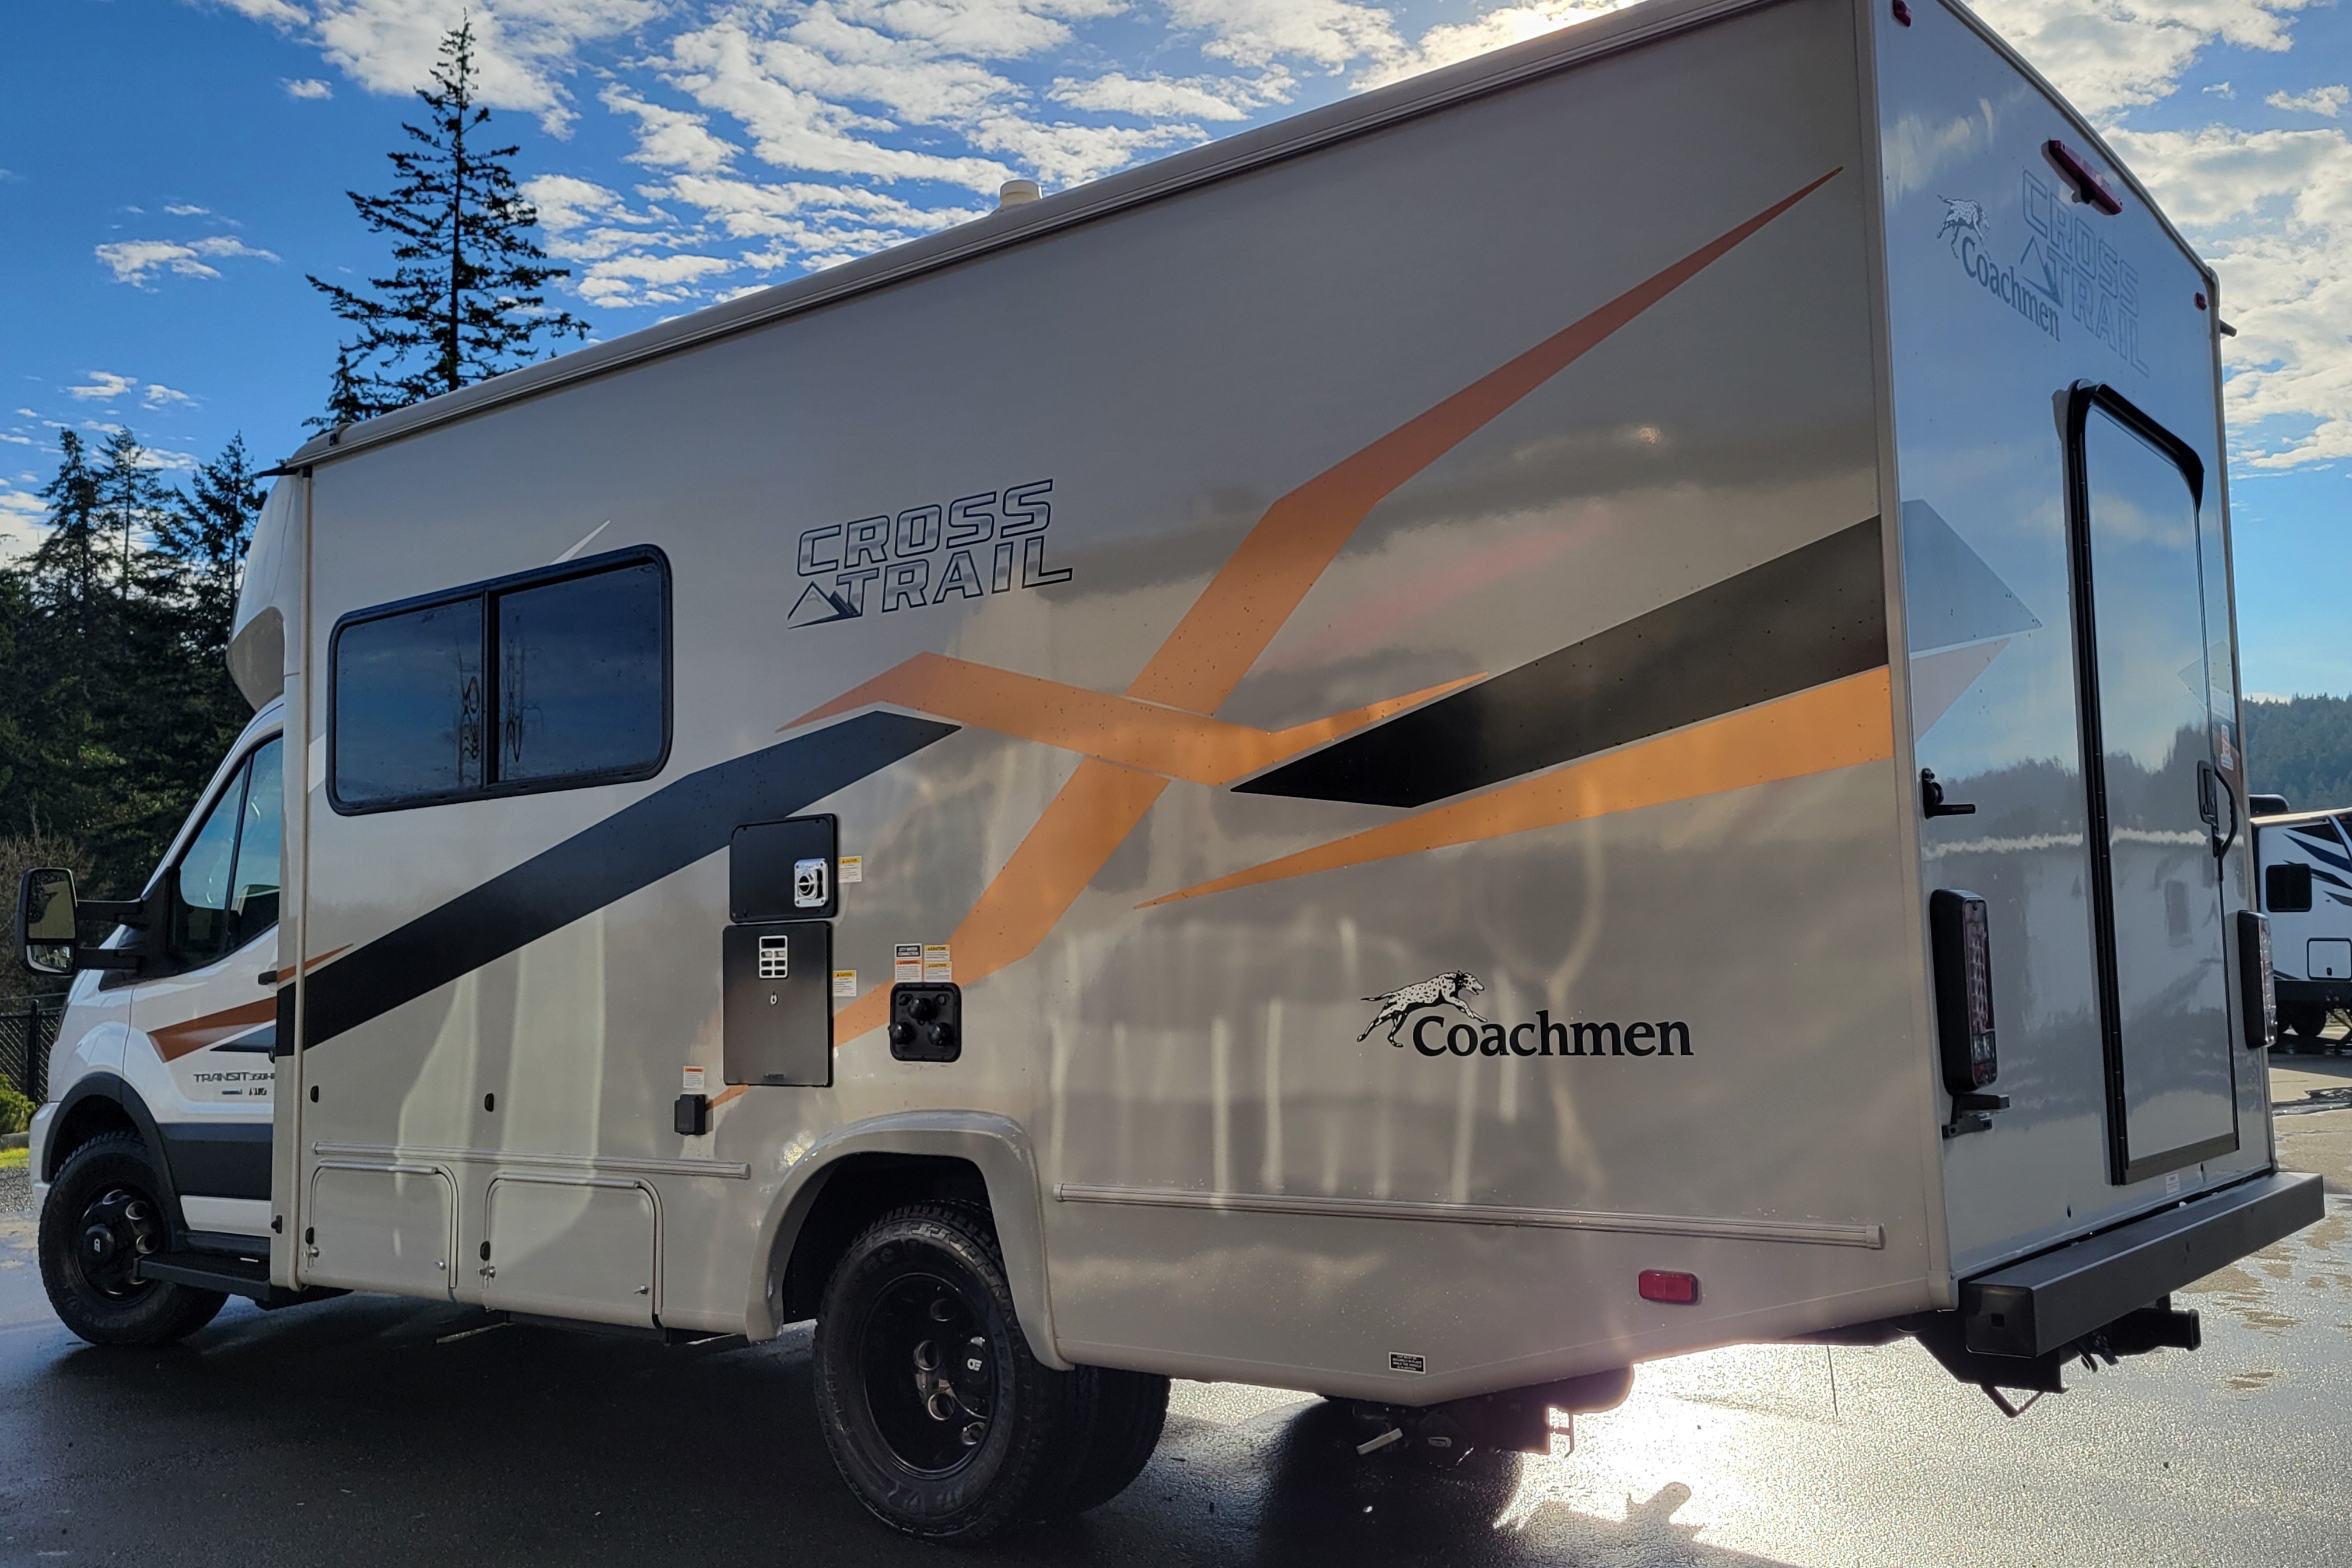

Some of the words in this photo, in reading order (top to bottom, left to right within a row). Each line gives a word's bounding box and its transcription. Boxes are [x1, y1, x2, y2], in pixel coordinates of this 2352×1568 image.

[1962, 236, 2060, 342] Coachmen
[2023, 170, 2138, 318] CROSS
[2047, 246, 2150, 378] TRAIL
[797, 478, 1053, 576] CROSS
[835, 535, 1073, 617] TRAIL
[193, 1072, 250, 1083] TRANSIT
[1412, 1010, 1694, 1056] Coachmen
